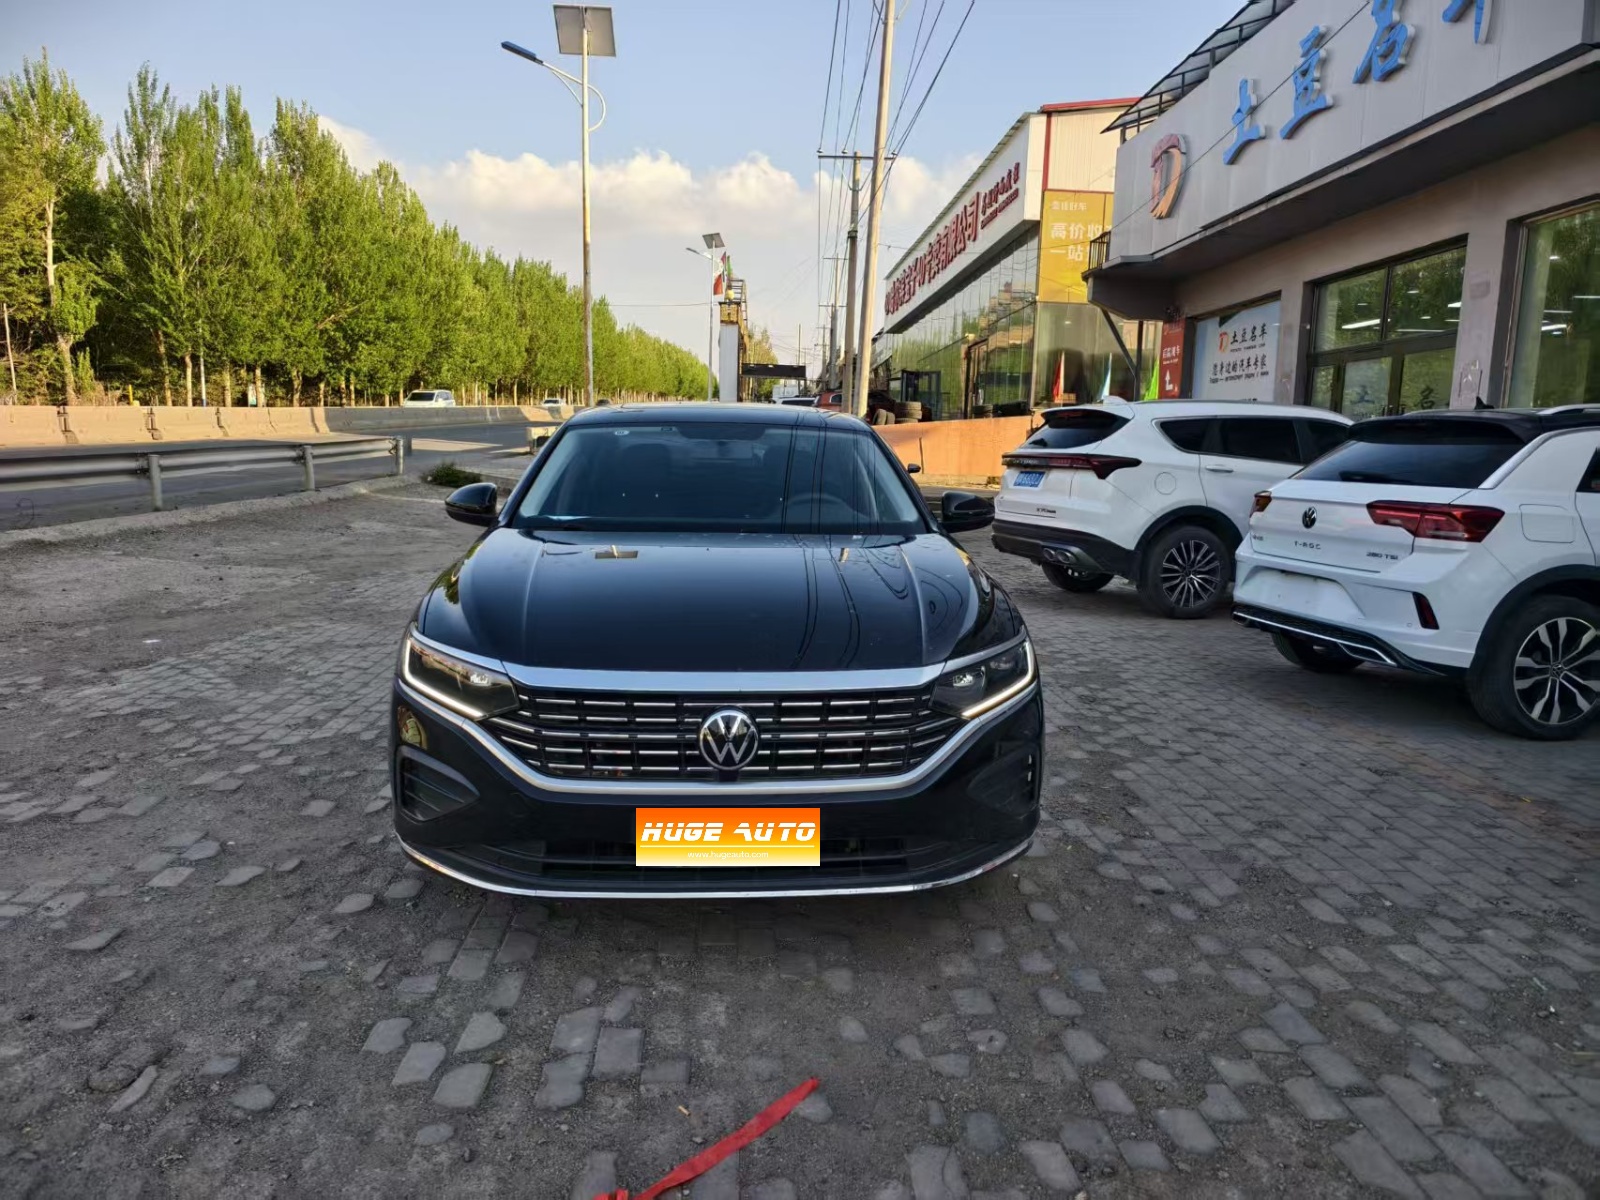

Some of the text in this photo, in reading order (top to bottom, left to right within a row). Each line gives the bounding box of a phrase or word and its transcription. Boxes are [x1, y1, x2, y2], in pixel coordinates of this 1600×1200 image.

[1051, 223, 1112, 241] 高价收
[1050, 245, 1093, 262] 一站
